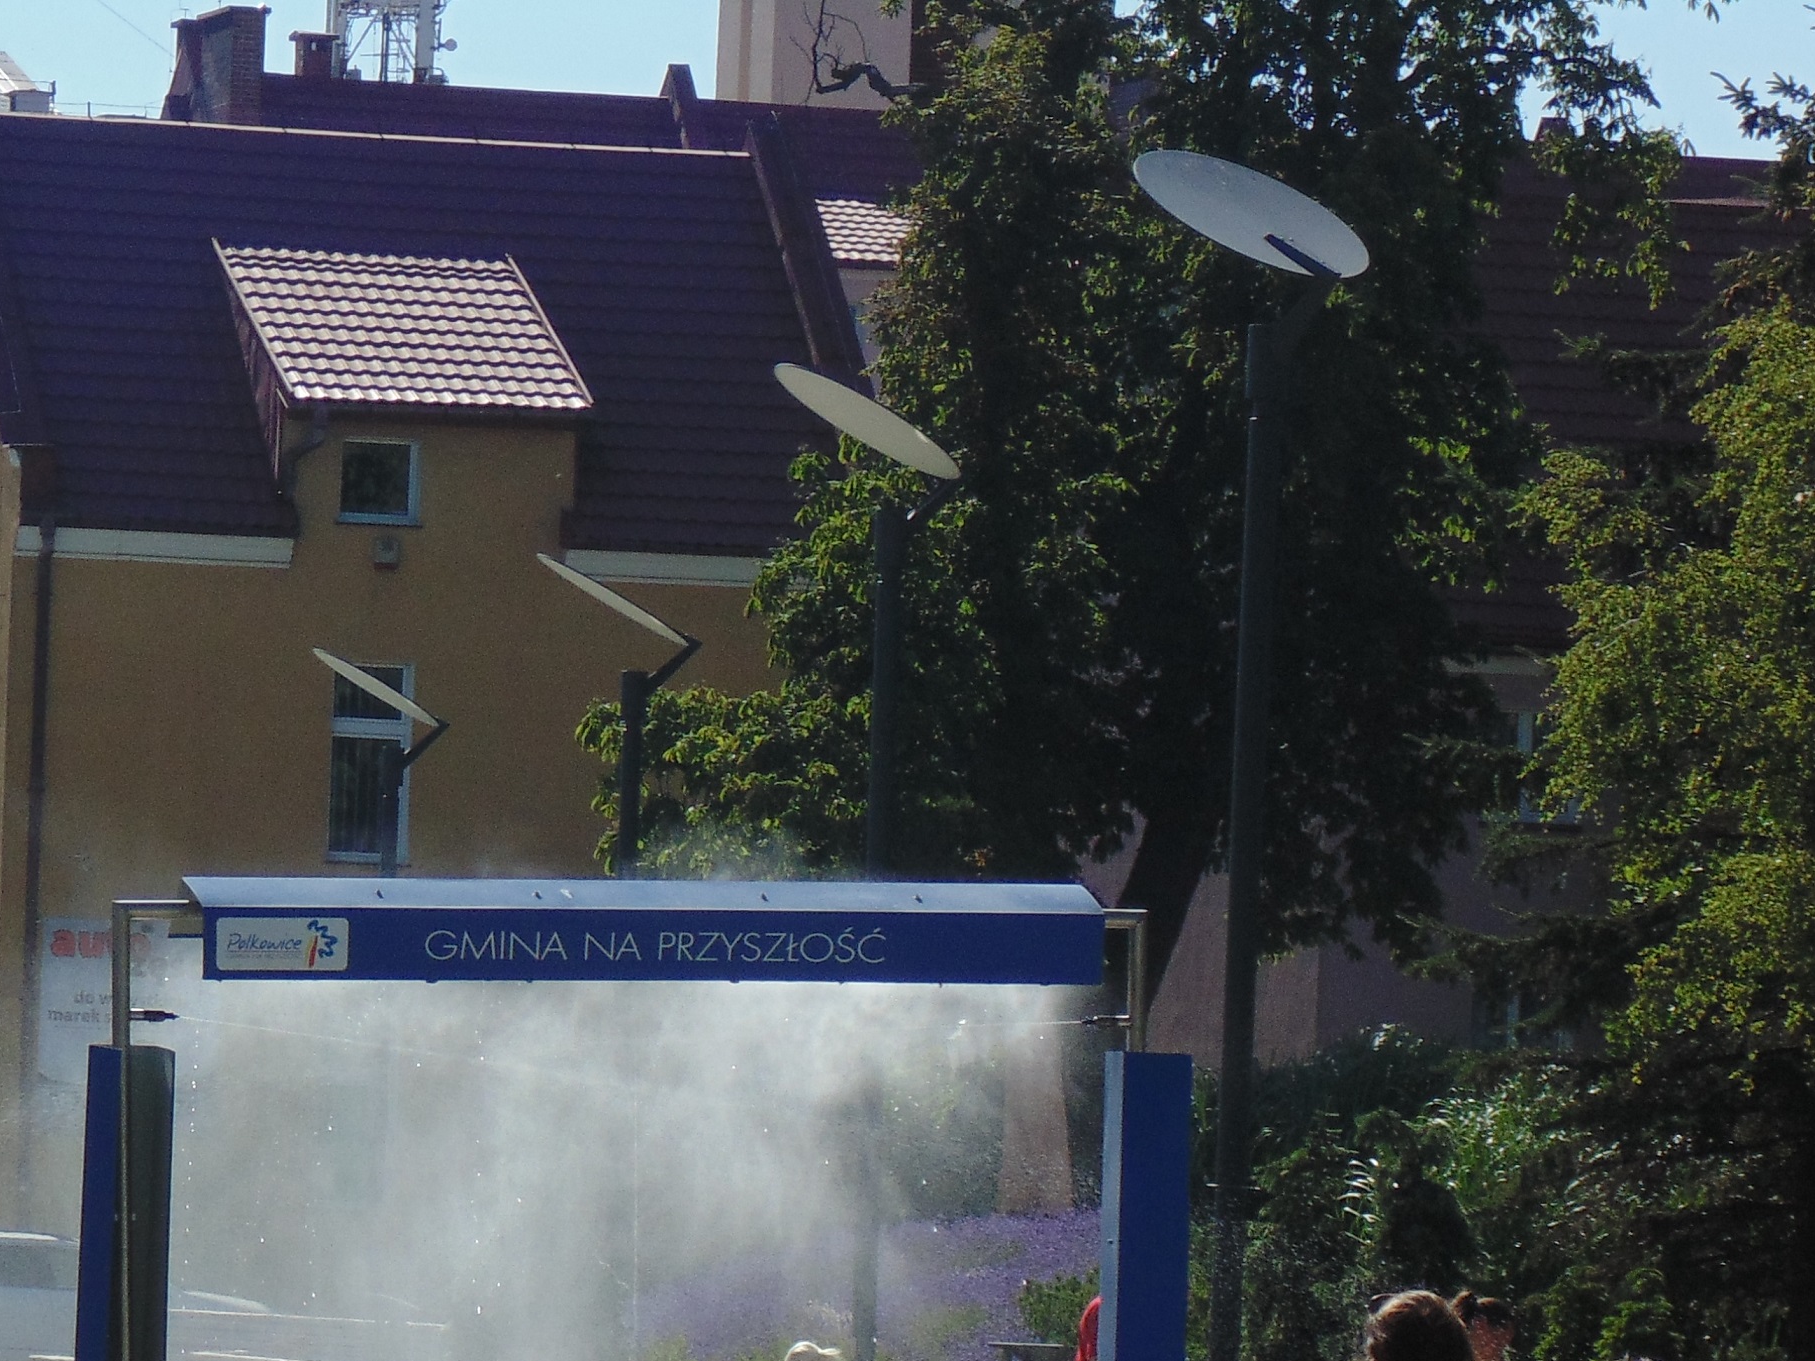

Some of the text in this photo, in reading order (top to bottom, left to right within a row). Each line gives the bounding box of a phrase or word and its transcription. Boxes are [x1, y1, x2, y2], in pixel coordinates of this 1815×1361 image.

[226, 932, 303, 951] Polkowice
[424, 926, 887, 964] GMINA NA PRZYSZŁOŚĆ
[47, 1008, 100, 1023] marek
